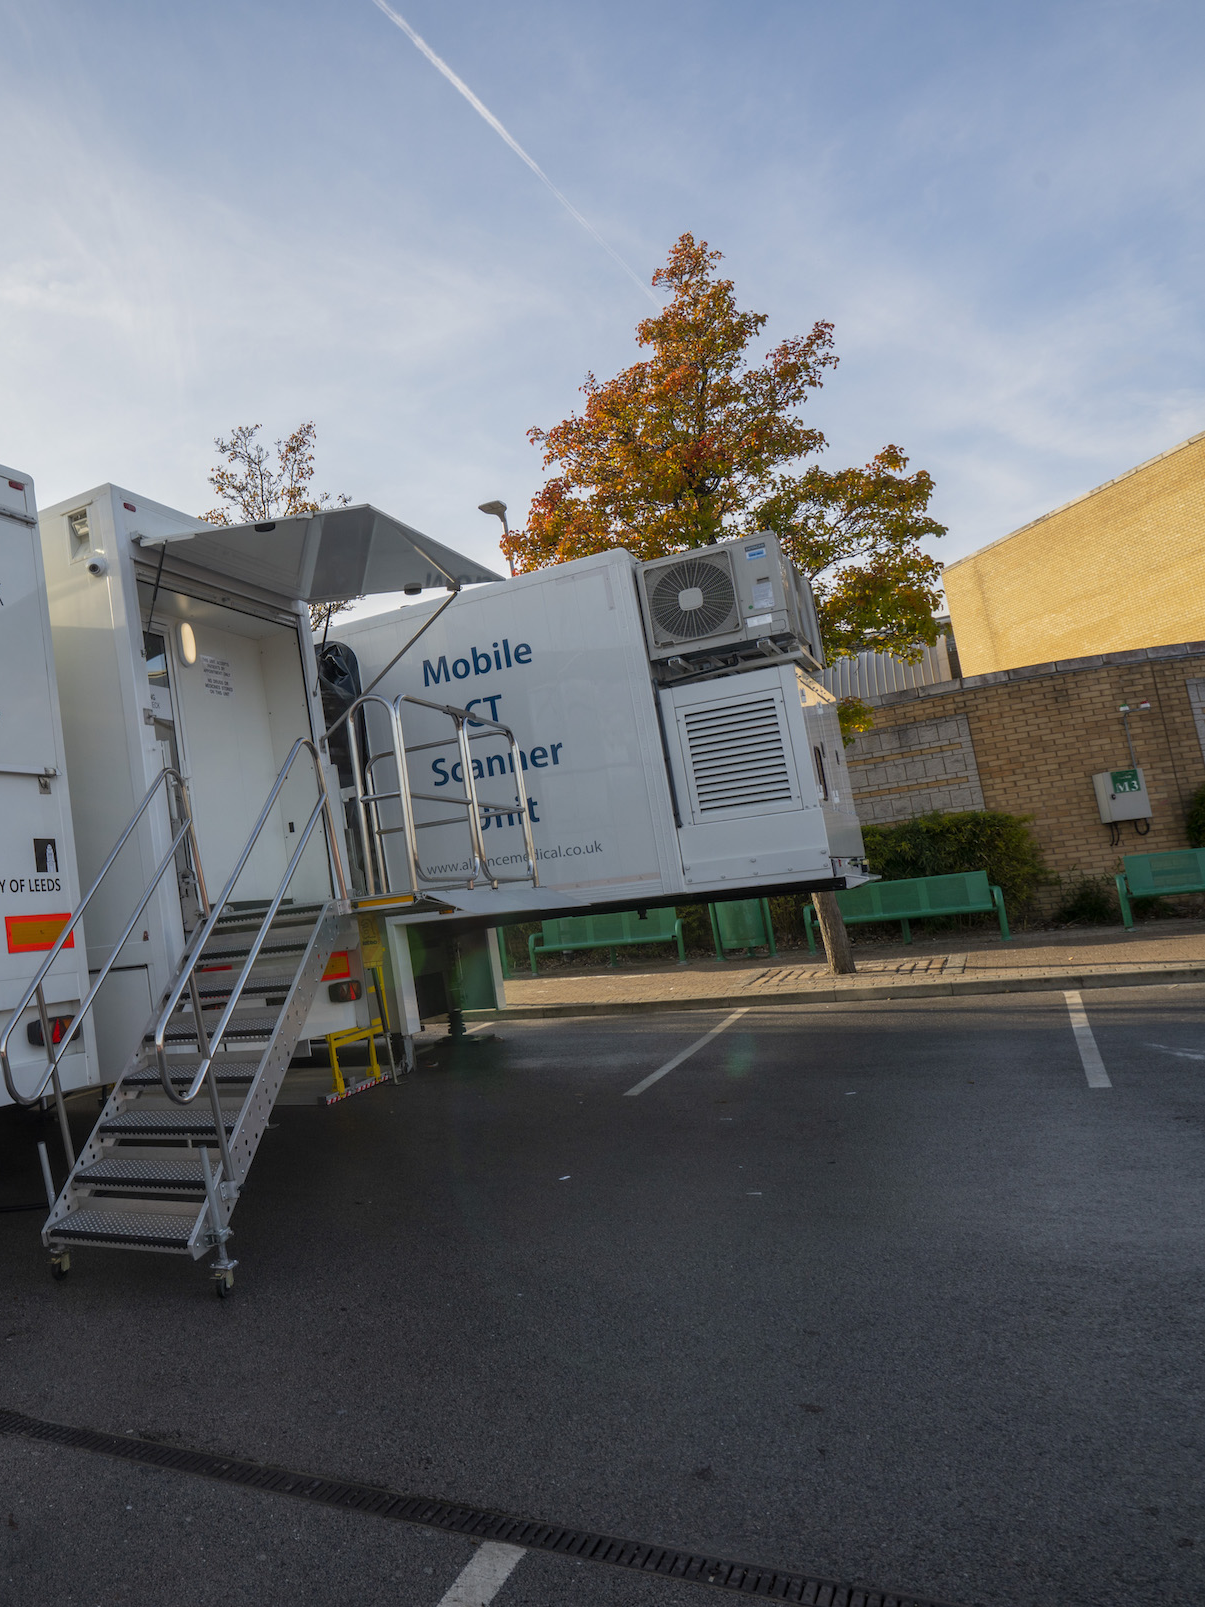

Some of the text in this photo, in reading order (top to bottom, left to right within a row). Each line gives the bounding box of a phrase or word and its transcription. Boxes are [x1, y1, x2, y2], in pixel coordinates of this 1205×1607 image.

[422, 639, 533, 687] Mobile
[464, 694, 502, 728] CT
[431, 742, 563, 786] Scanner
[9, 879, 25, 893] OF
[28, 878, 61, 893] LEEDS
